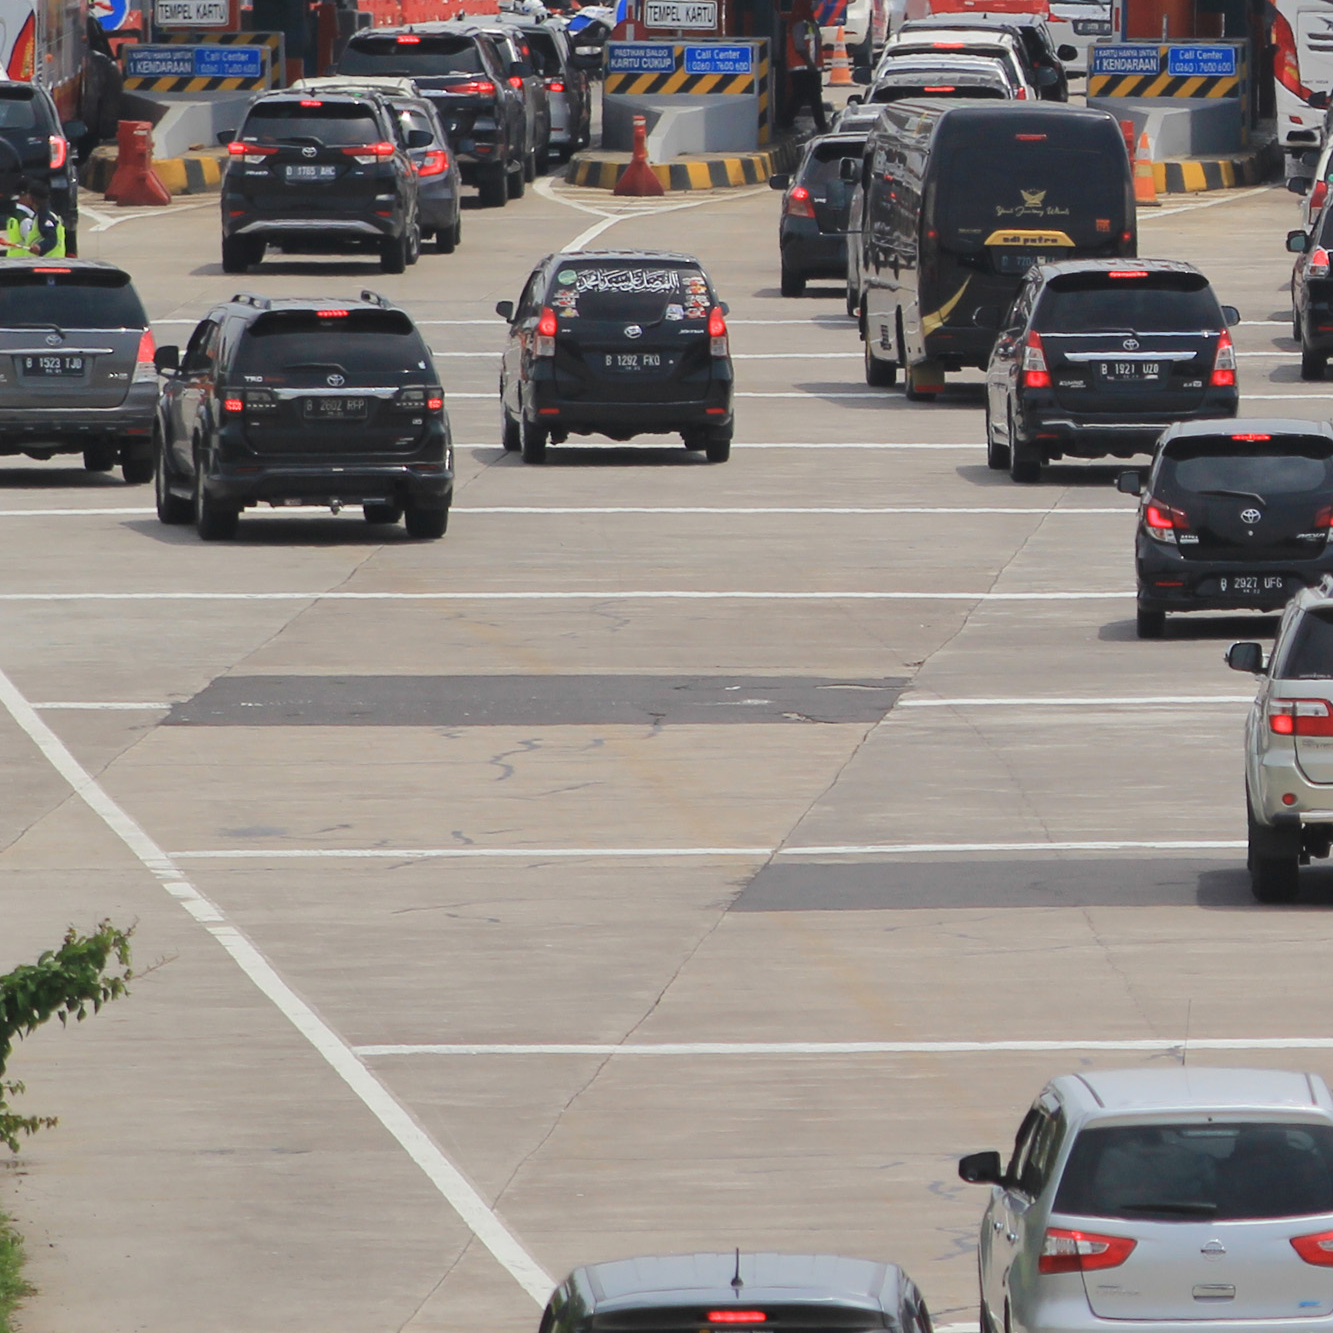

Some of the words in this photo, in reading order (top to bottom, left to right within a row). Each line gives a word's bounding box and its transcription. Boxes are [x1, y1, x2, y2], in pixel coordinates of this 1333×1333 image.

[159, 4, 192, 19] TEMPEL
[196, 4, 225, 20] KARTU
[649, 6, 681, 22] TEMPEL
[686, 6, 714, 23] KARTU
[696, 51, 712, 60] Call
[714, 51, 741, 60] Center
[1180, 51, 1195, 59] Call
[1197, 51, 1223, 59] Center
[136, 62, 192, 73] KENDARAAN
[611, 58, 640, 68] KARTU
[642, 58, 672, 68] CUKUP
[1103, 59, 1157, 70] KENDARAAN
[26, 358, 33, 369] B
[40, 358, 62, 369] 1523
[606, 356, 612, 366] B
[618, 356, 638, 366] 1292
[1102, 364, 1108, 375] B
[1115, 364, 1135, 374] 1921
[1221, 578, 1228, 588] B
[1234, 578, 1258, 588] 2927
